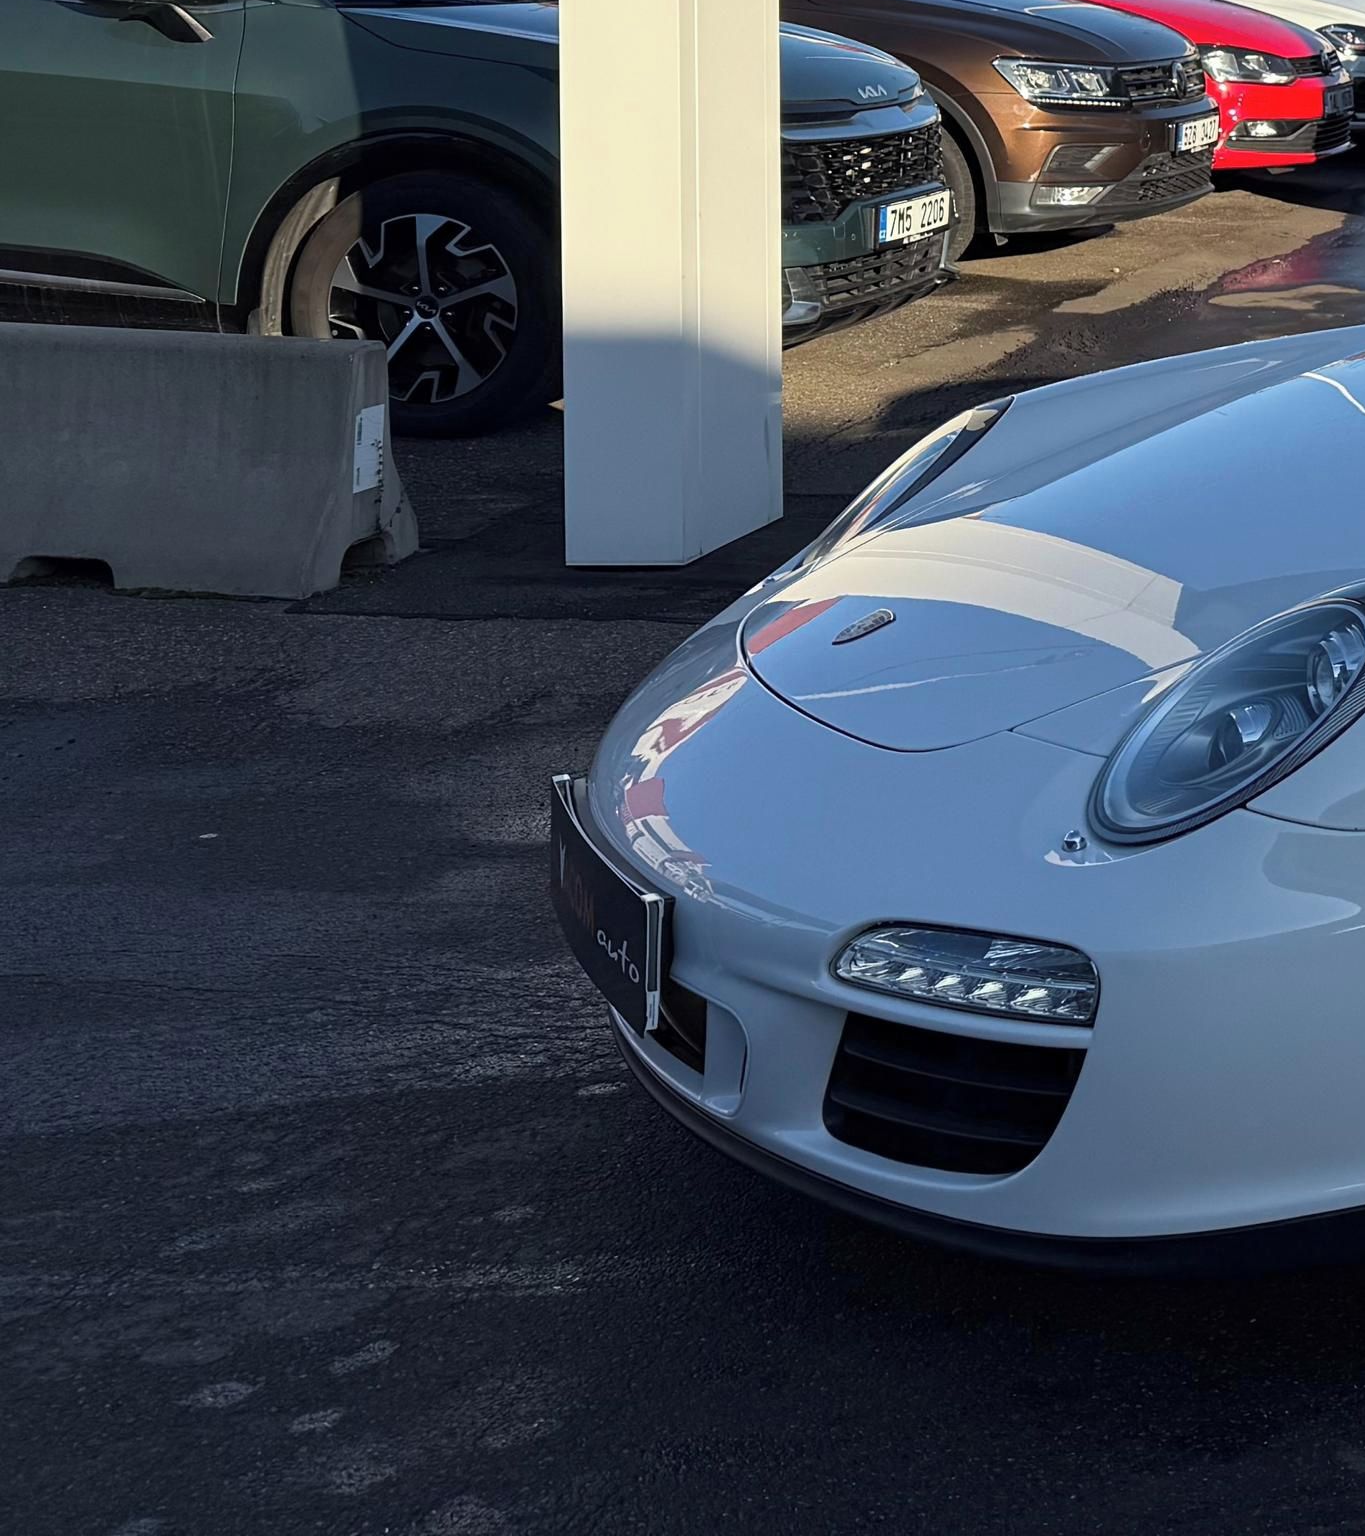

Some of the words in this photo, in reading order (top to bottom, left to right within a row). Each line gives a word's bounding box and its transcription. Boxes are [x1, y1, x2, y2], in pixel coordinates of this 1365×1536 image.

[889, 206, 913, 238] 7M5
[920, 197, 945, 229] 2206
[596, 928, 641, 984] auto
